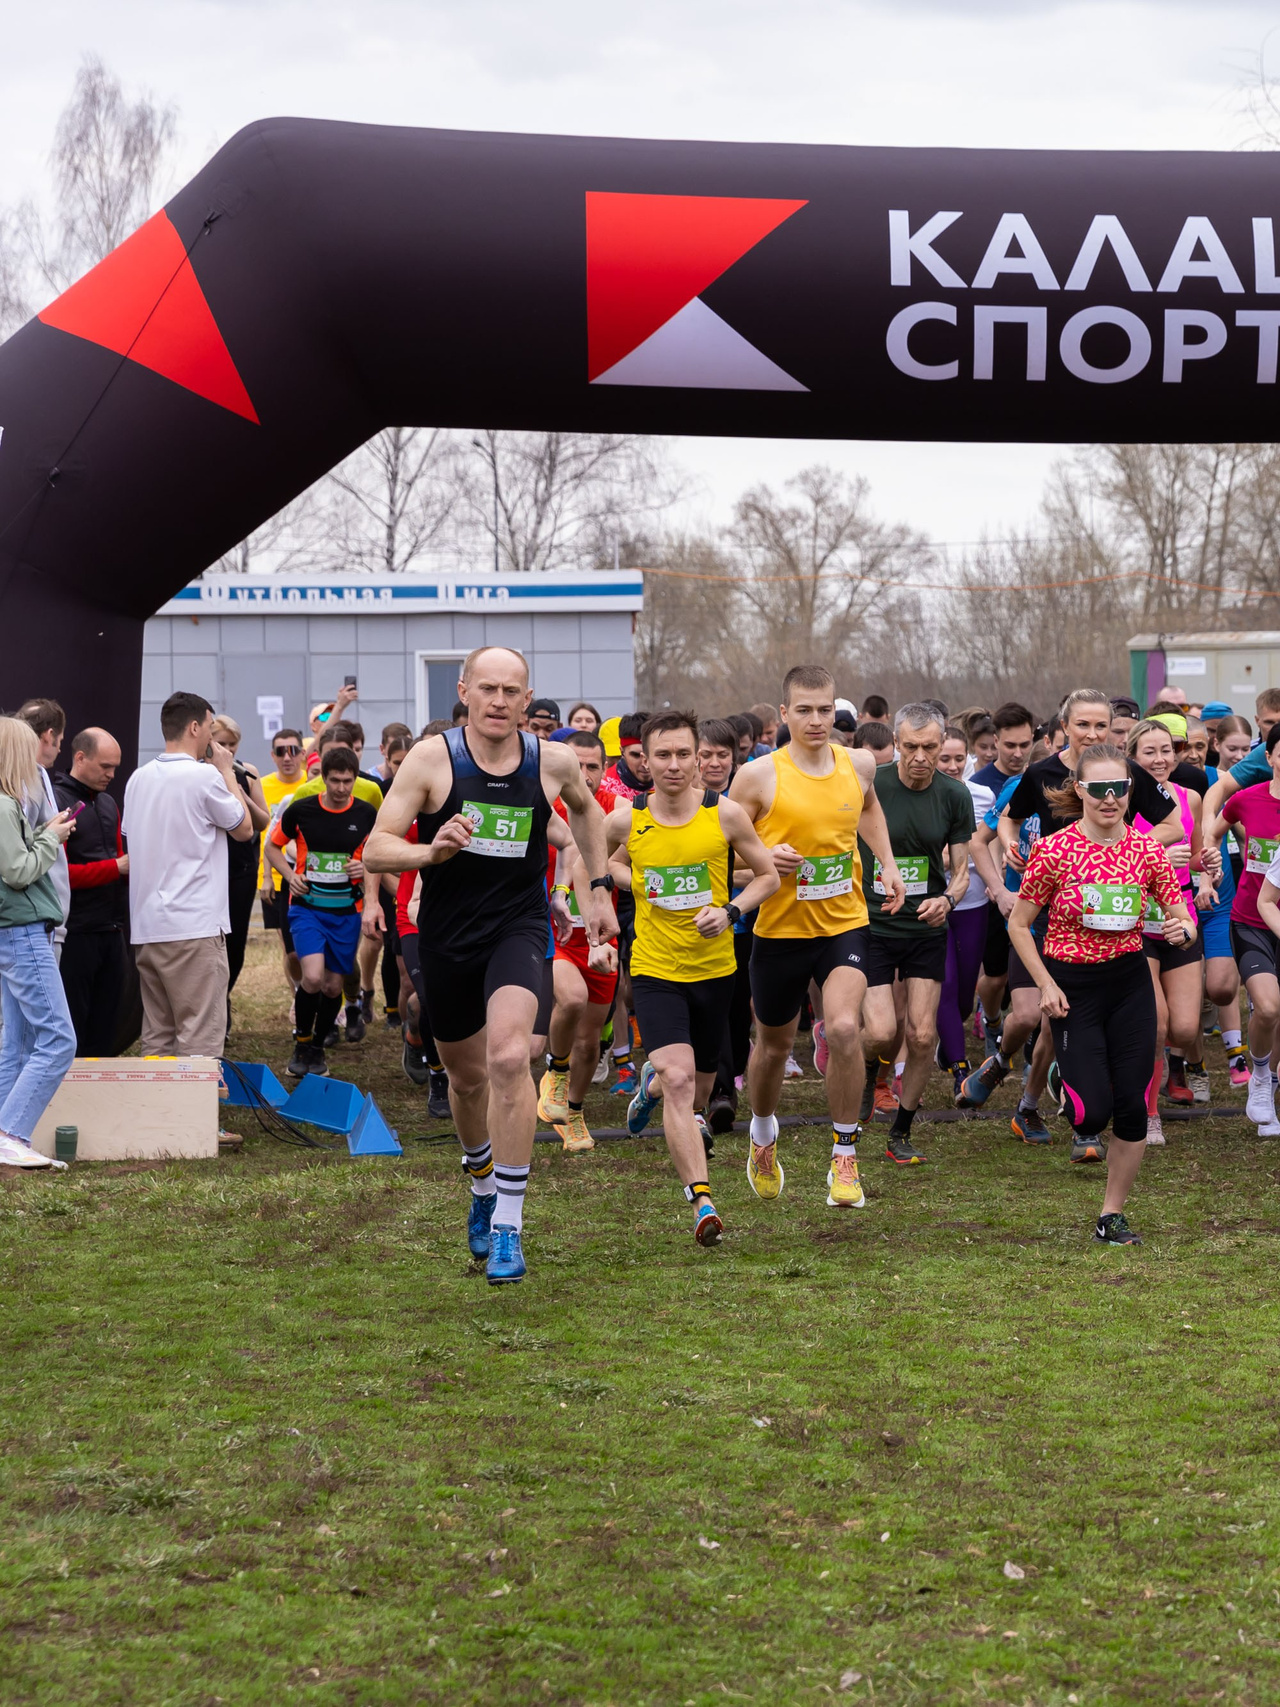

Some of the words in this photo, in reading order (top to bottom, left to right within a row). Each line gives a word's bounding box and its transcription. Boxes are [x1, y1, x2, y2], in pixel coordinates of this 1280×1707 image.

[495, 818, 518, 838] 51
[325, 861, 342, 872] 48
[825, 864, 844, 882] 22
[899, 867, 919, 880] 82
[674, 875, 699, 892] 28
[1112, 896, 1133, 913] 92
